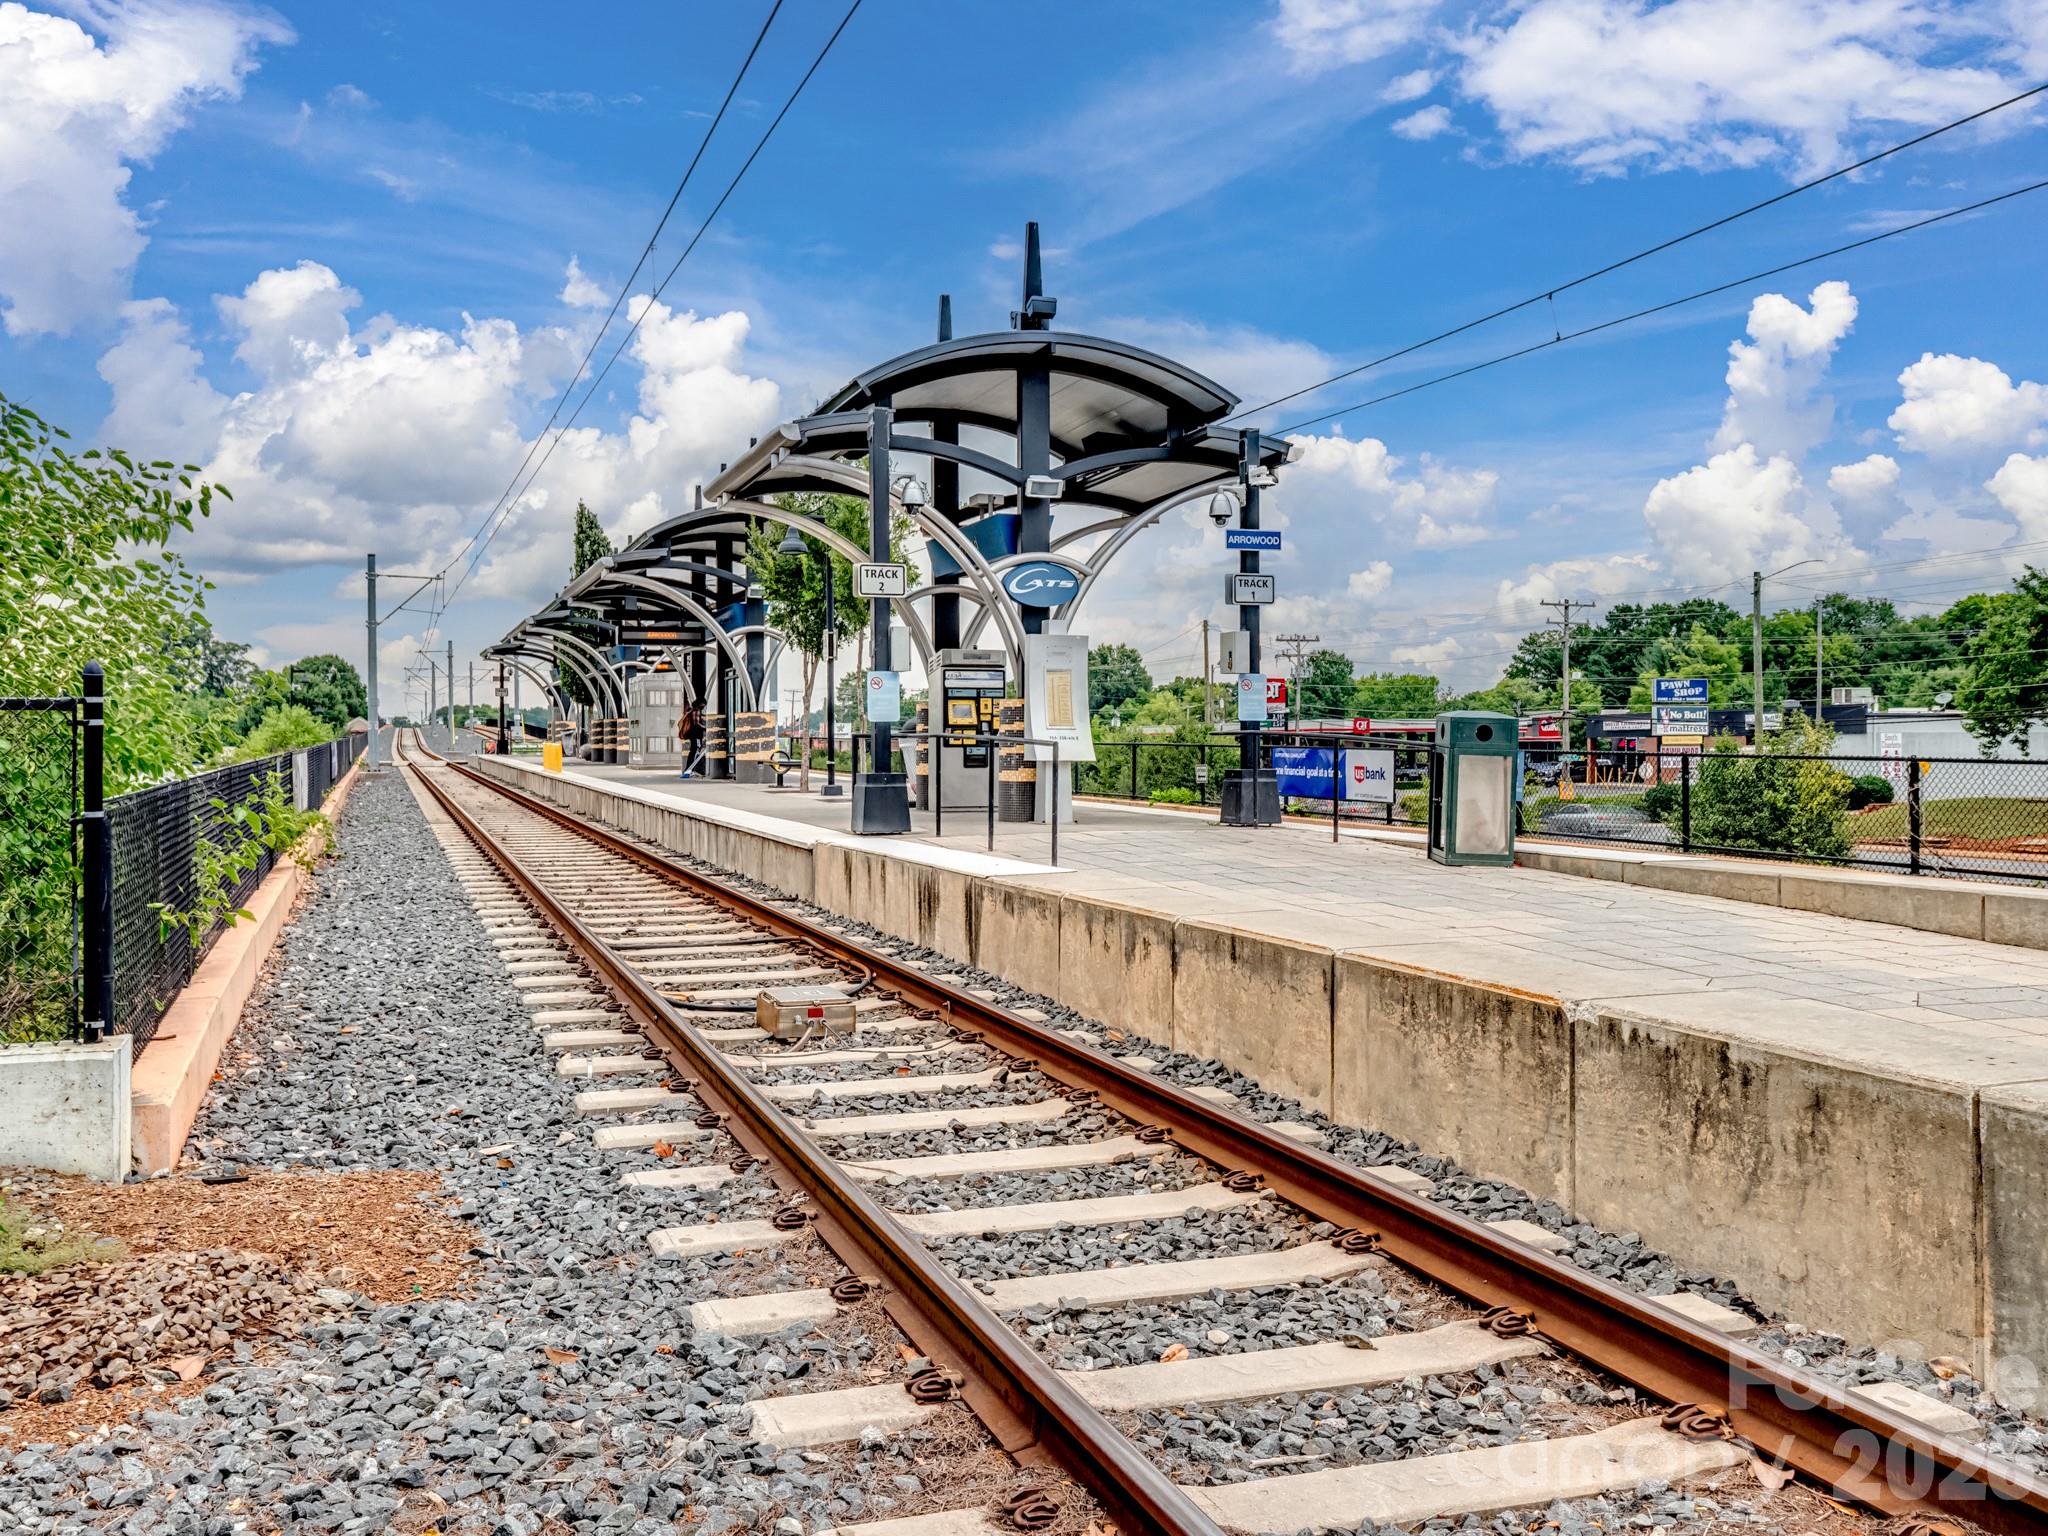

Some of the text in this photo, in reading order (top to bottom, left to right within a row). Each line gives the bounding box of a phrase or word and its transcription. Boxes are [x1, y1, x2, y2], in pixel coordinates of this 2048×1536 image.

[1228, 535, 1280, 545] ARROWOOD
[864, 569, 899, 579] TRACK
[1009, 568, 1076, 593] CATS
[1238, 579, 1269, 588] TRACK
[878, 582, 885, 592] 2
[1251, 591, 1256, 600] 1
[1660, 680, 1691, 690] PAWN
[1674, 687, 1704, 696] SHOP
[1670, 710, 1707, 719] No Bull!
[1356, 721, 1369, 730] QT
[1669, 725, 1707, 733] mattress
[1284, 765, 1305, 776] financial
[1306, 766, 1318, 779] goal
